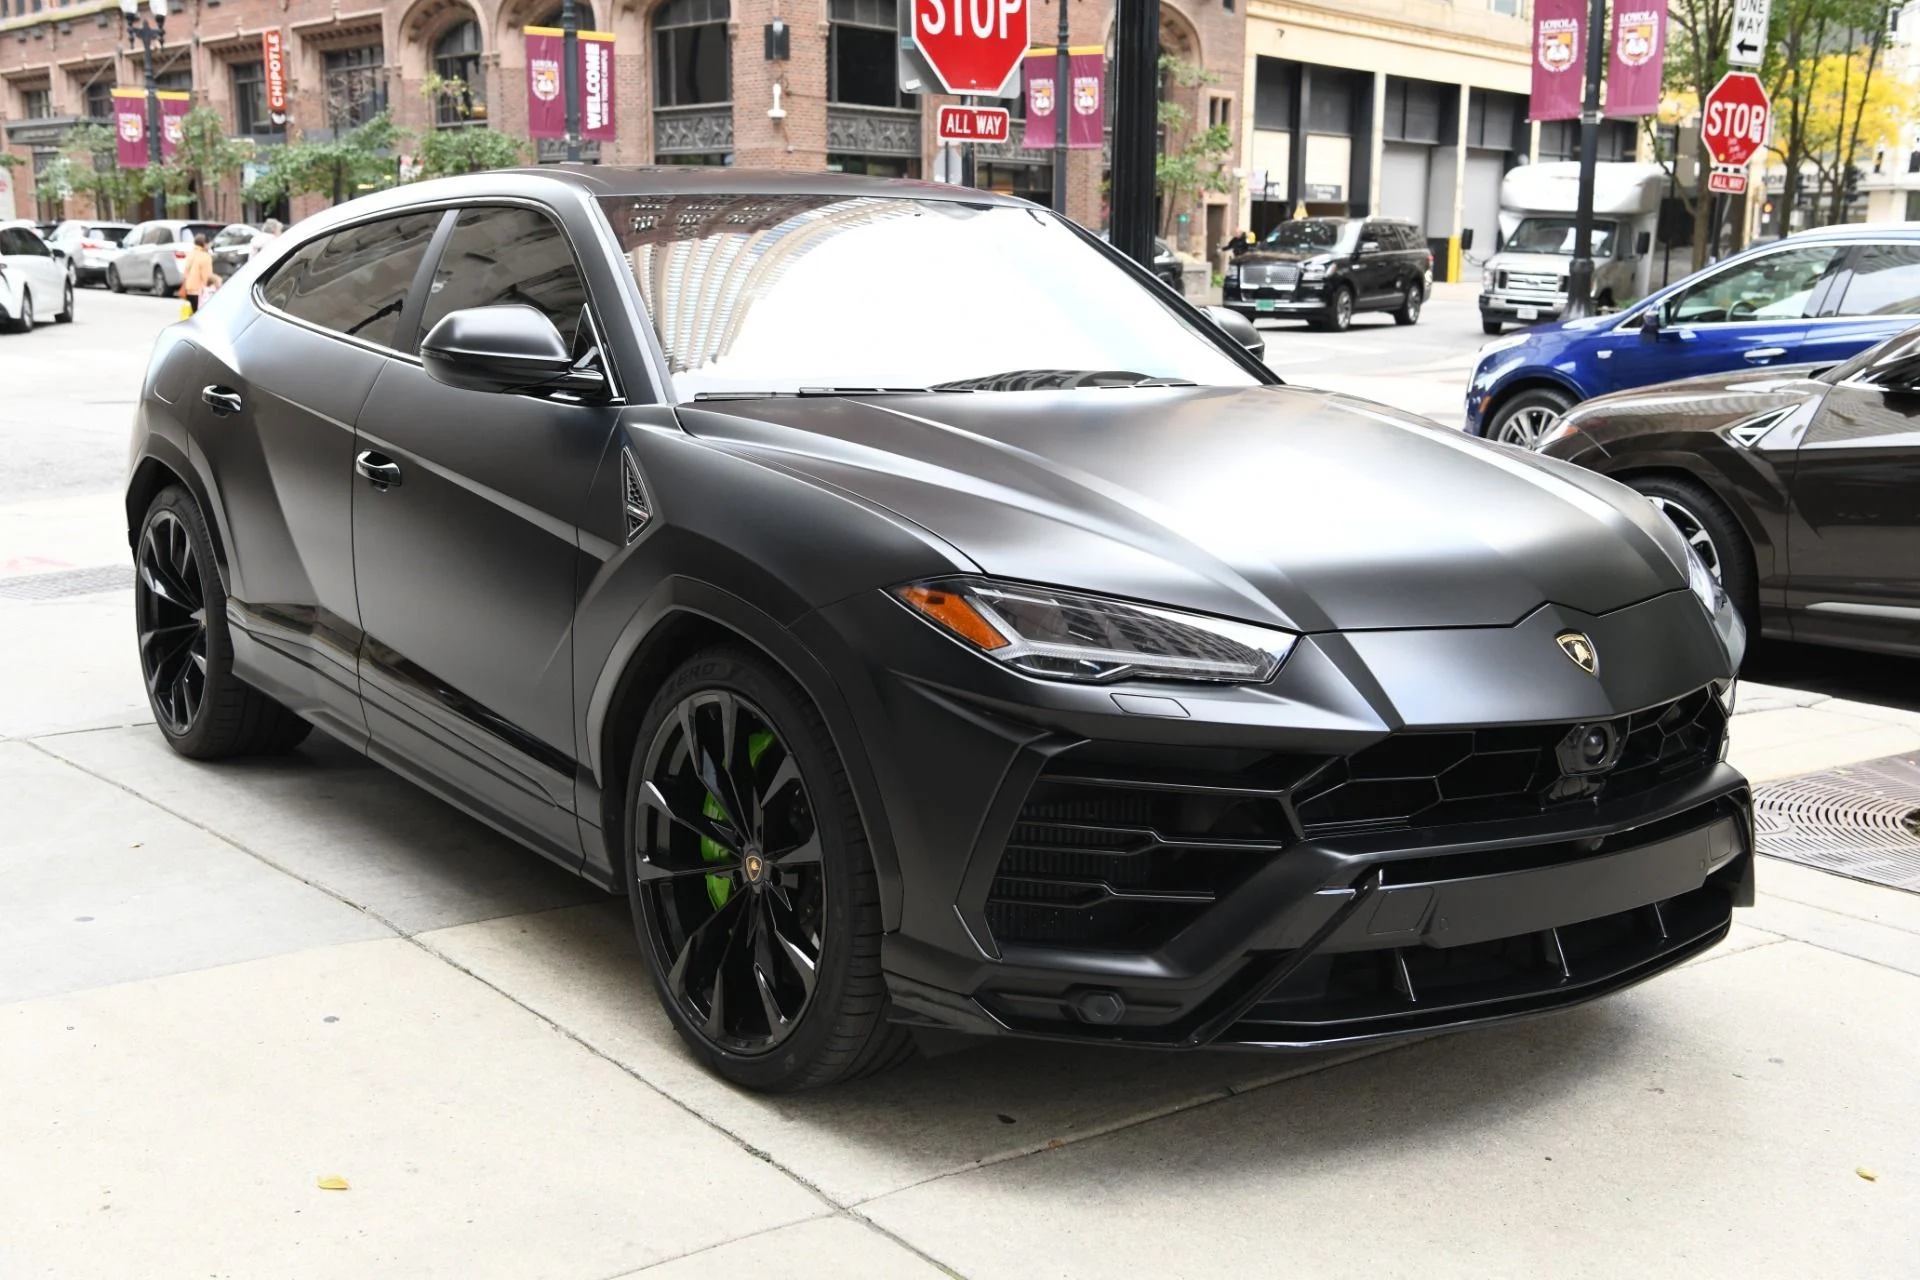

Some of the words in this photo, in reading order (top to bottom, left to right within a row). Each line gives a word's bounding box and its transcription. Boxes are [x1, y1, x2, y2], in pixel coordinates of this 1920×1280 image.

[1619, 11, 1658, 23] LOYOLA
[1740, 0, 1764, 14] ONE
[921, 0, 1021, 38] STOP
[1540, 18, 1578, 29] LOYOLA
[1738, 16, 1763, 34] WAY
[267, 34, 283, 107] CHIPOTLE
[585, 43, 601, 129] WELCOME
[946, 113, 971, 133] ALL
[976, 115, 1002, 135] WAY
[1707, 101, 1765, 139] STOP
[1712, 176, 1727, 188] ALL
